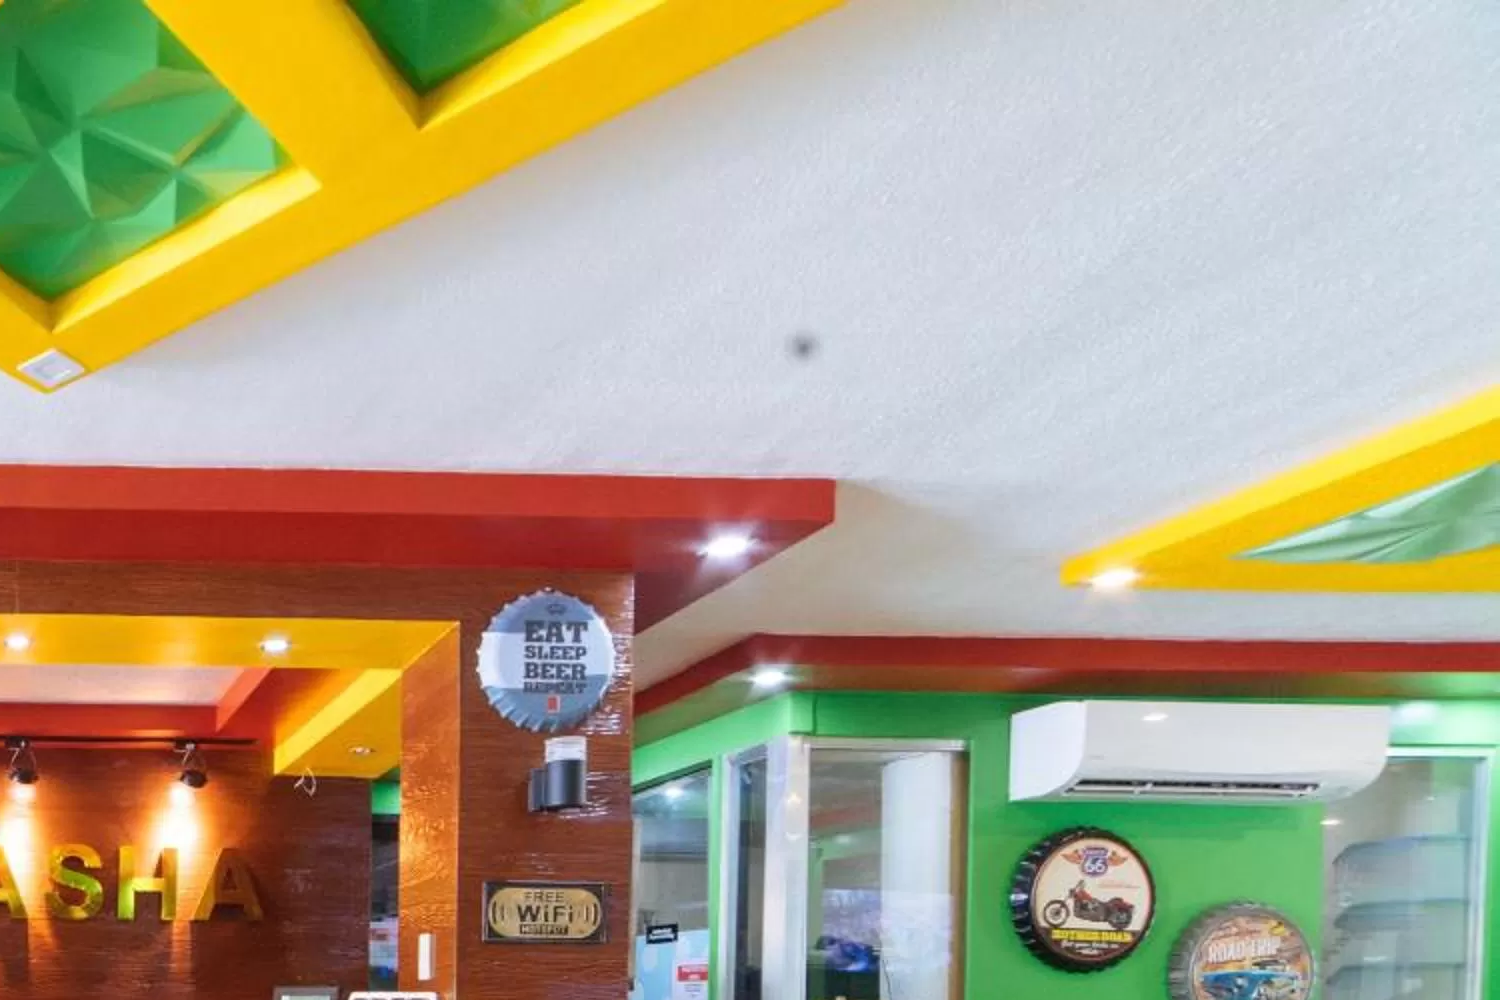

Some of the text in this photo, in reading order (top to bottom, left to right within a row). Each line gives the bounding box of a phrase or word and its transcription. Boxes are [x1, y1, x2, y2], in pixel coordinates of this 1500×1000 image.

[524, 620, 589, 643] EAT
[524, 645, 587, 660] SLEEP
[523, 661, 587, 681] BEER
[523, 681, 587, 694] REPEAT
[1084, 857, 1106, 873] 66
[524, 891, 565, 903] FREE
[517, 904, 574, 924] WiFi
